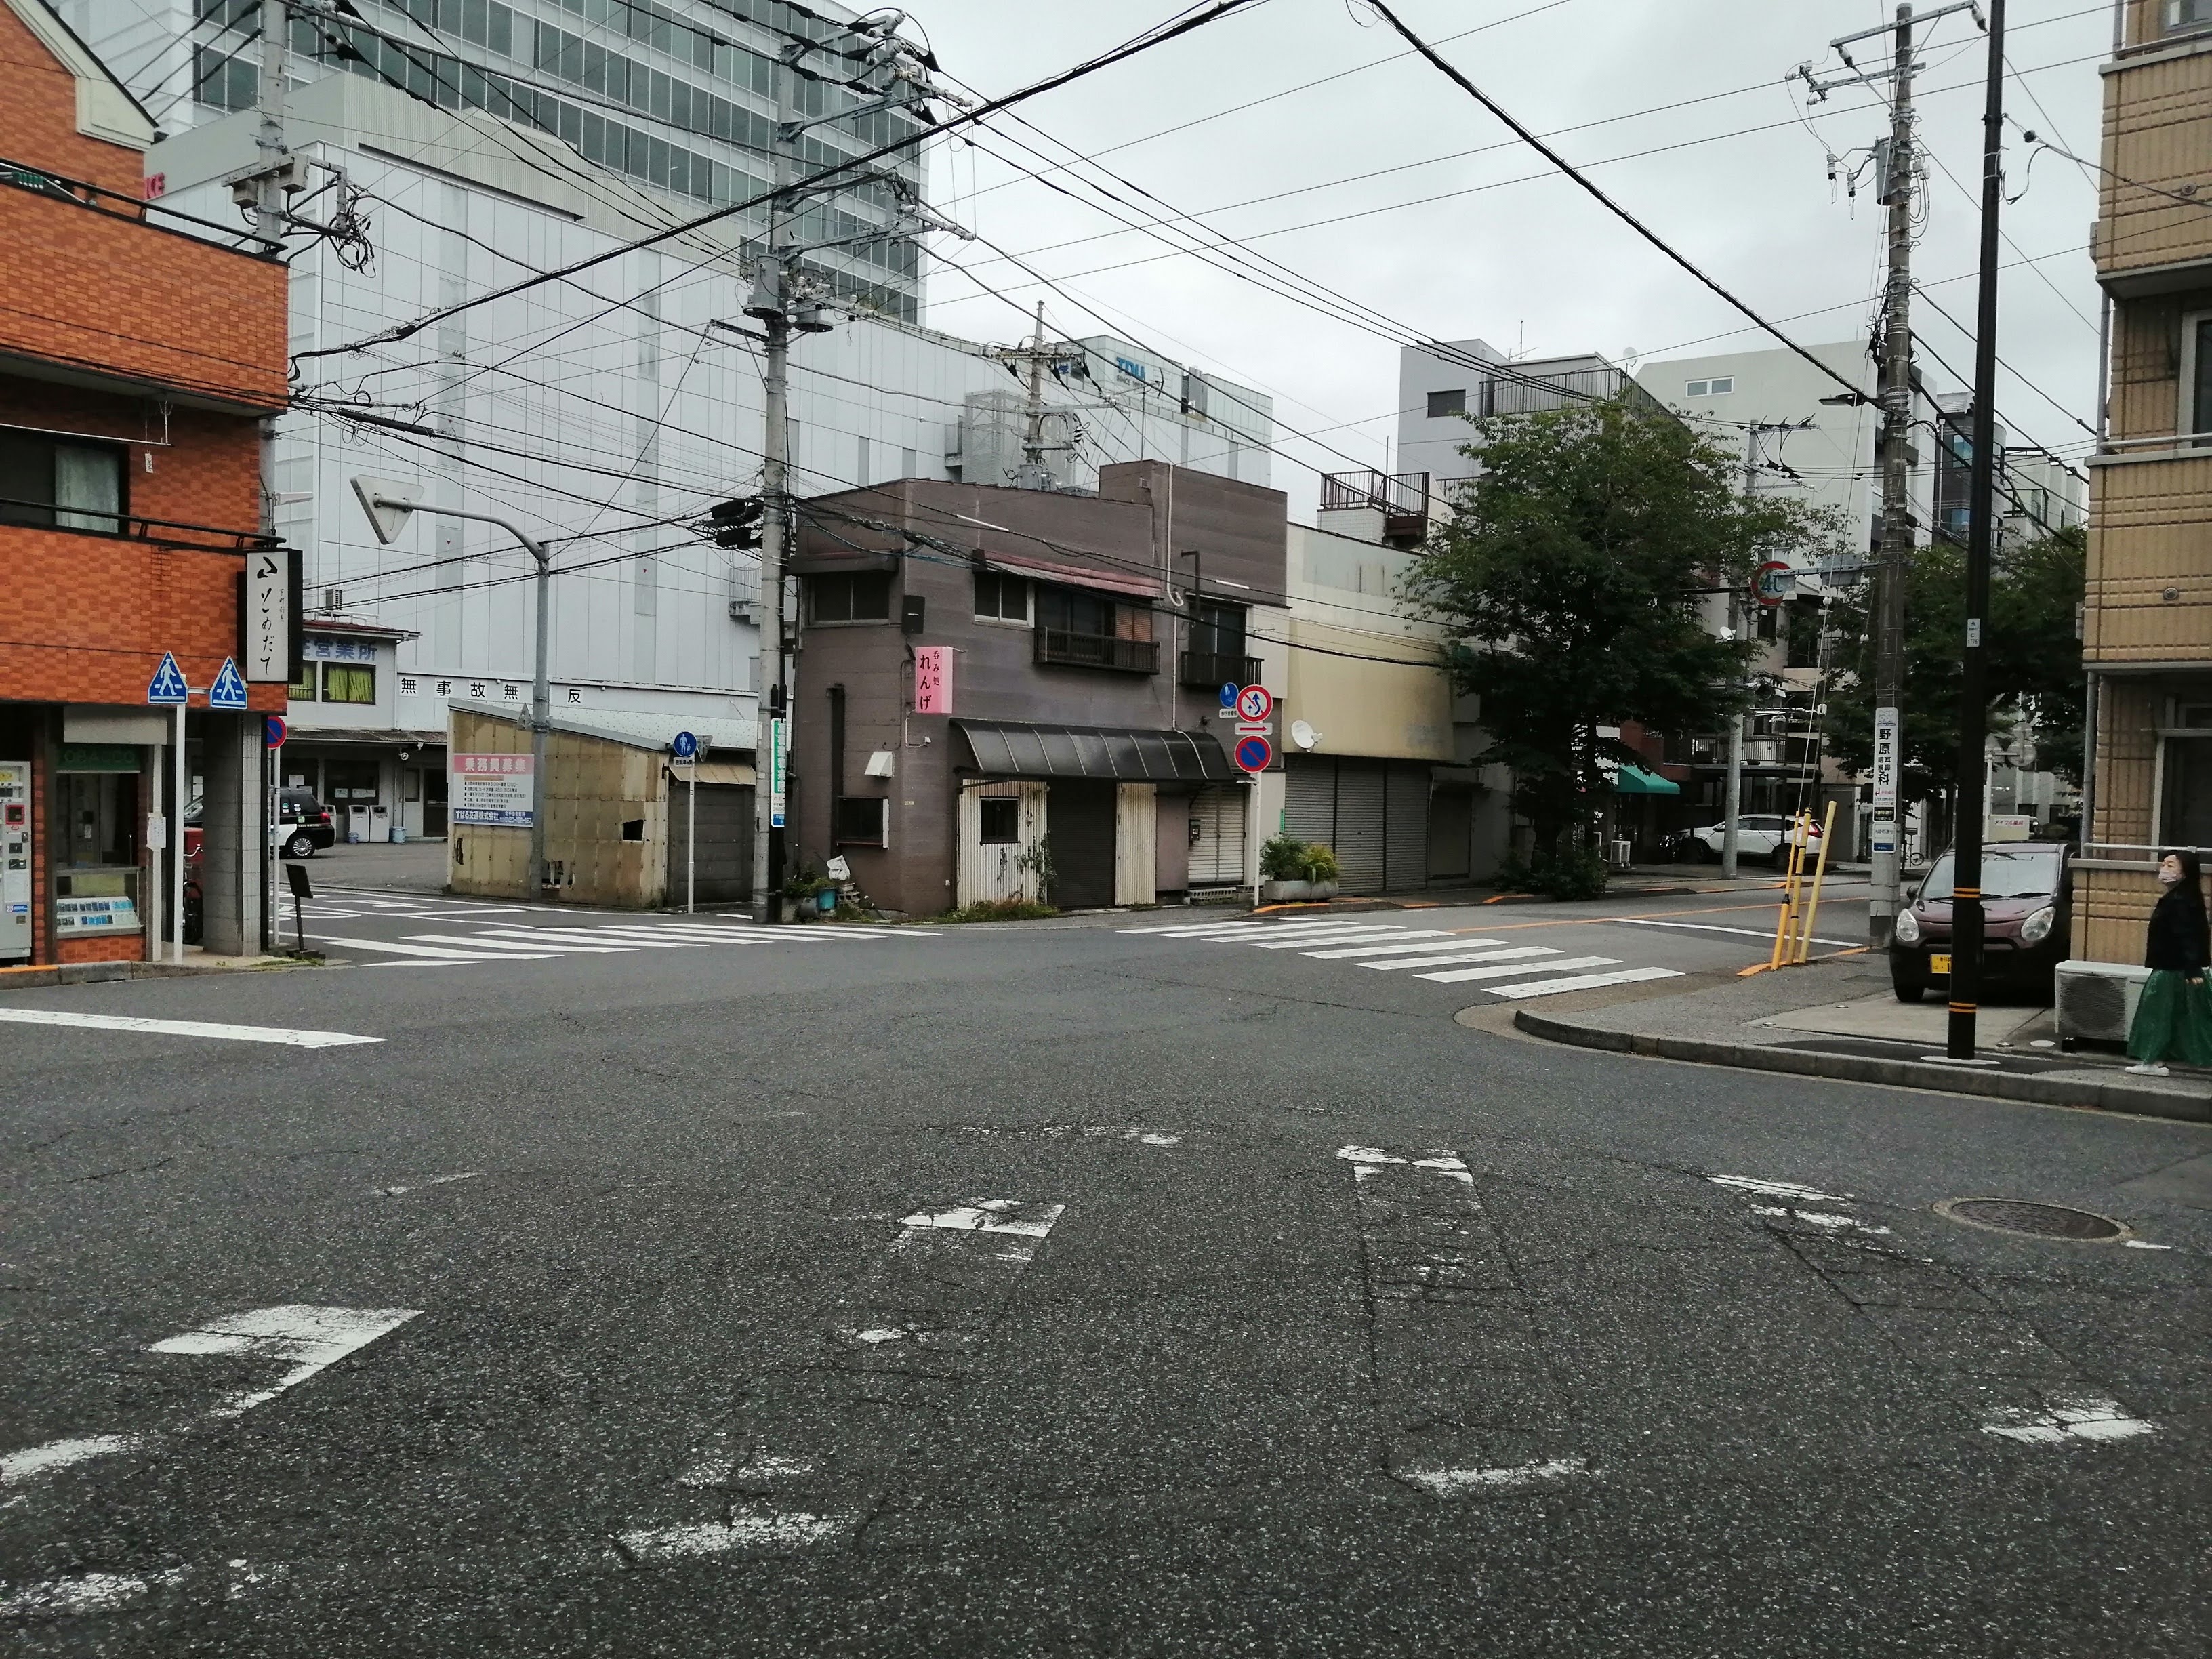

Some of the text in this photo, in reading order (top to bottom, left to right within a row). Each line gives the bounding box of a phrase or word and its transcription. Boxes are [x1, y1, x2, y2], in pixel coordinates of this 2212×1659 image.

[1116, 356, 1145, 381] TDU
[920, 655, 932, 710] れんげ
[465, 758, 526, 772] 乗務員募集
[455, 810, 499, 821] すばる交通株式会社
